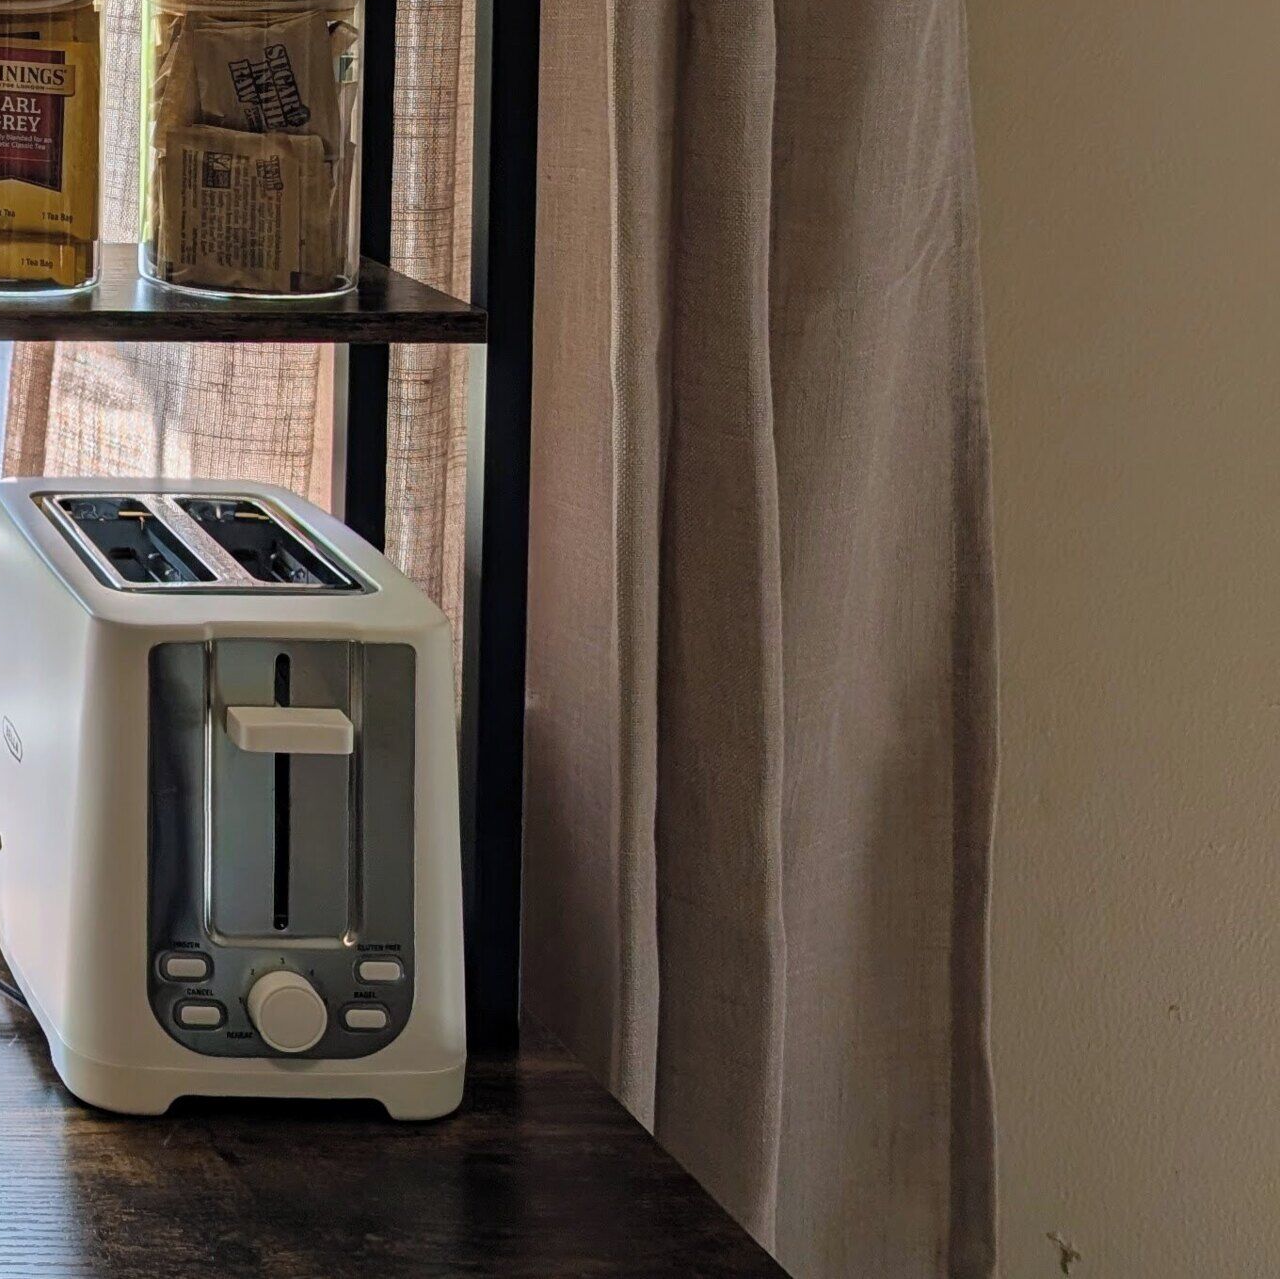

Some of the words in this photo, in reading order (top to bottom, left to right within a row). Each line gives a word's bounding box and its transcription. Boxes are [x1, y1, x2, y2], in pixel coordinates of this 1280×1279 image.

[3, 208, 16, 218] Tea
[47, 212, 59, 221] Tea
[60, 213, 73, 224] Bag
[26, 258, 38, 267] Tea
[40, 258, 53, 269] Bag
[357, 943, 384, 951] GLUTEN
[186, 988, 214, 996] CANCEL
[354, 991, 377, 999] BAGEL
